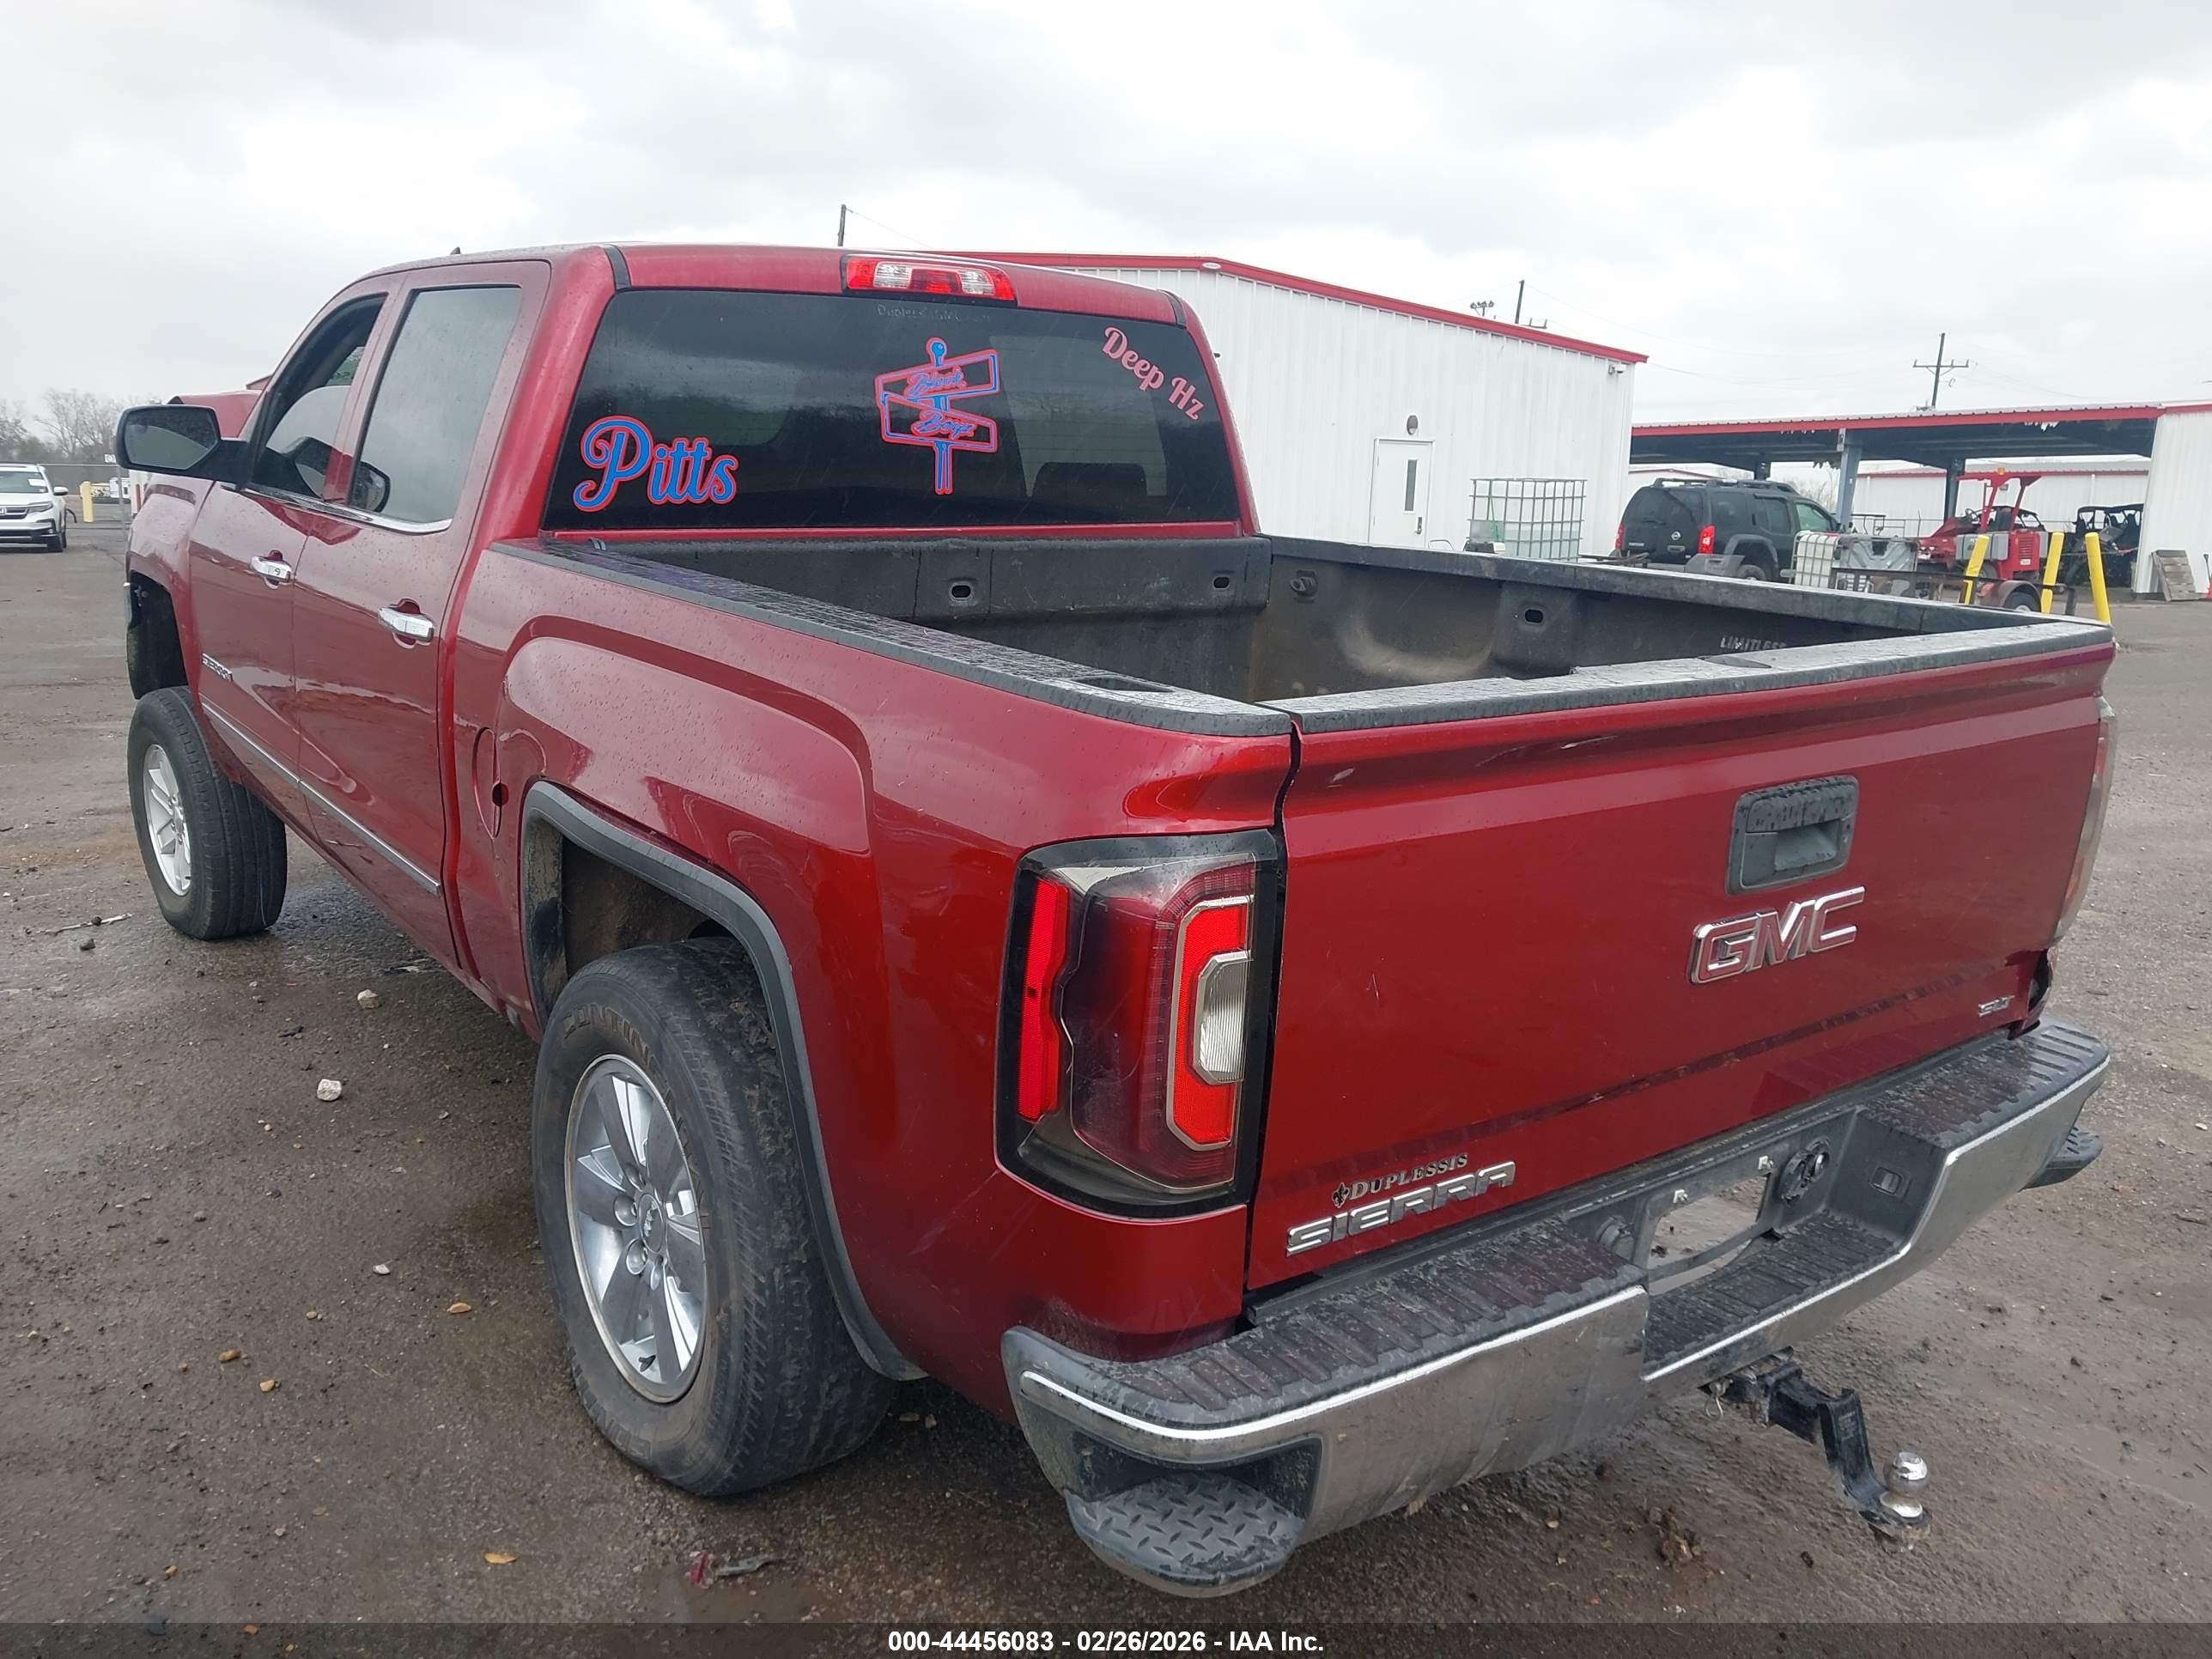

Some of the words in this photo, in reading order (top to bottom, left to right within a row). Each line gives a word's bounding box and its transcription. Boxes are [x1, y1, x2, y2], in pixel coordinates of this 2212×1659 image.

[1101, 325, 1165, 392] Deep
[1168, 376, 1205, 421] Hz
[573, 415, 739, 512] Pitts
[1688, 885, 1865, 983] GMC
[1286, 1160, 1516, 1257] SIERRA
[1348, 1152, 1468, 1201] DUPLESSIS
